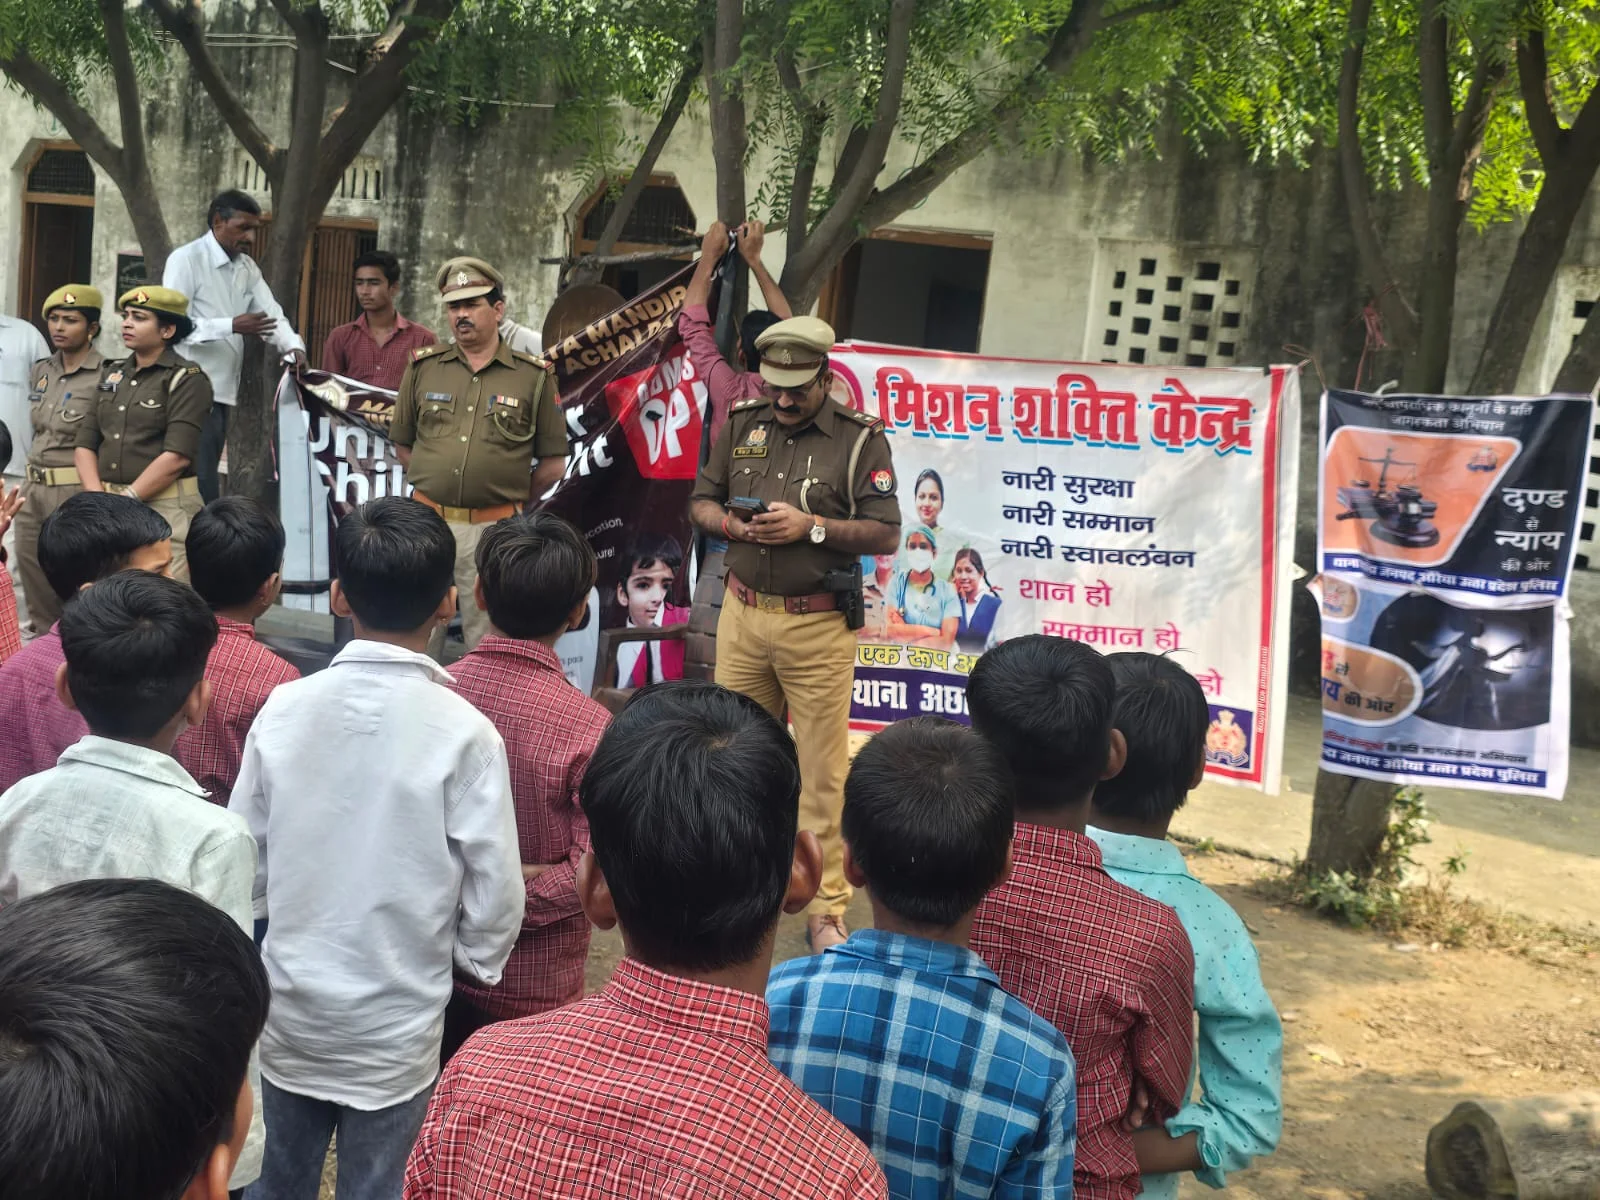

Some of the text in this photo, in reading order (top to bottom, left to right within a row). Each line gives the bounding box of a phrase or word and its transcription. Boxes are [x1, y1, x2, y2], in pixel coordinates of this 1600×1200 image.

[873, 366, 1254, 457] मिशन शक्ति केन्द्र
[1493, 401, 1507, 414] के
[1001, 466, 1136, 503] नारी सुरक्षा
[1501, 487, 1568, 513] दण्ड
[1002, 501, 1156, 533] नारी सम्मान
[1525, 516, 1539, 531] से
[1001, 535, 1197, 568] नारी स्वावलंबन
[1494, 530, 1565, 551] न्याय
[1501, 557, 1551, 571] की ओर
[1019, 578, 1112, 607] शान हो
[1153, 621, 1181, 651] हो
[857, 644, 903, 666] एक
[906, 645, 951, 671] रूप
[853, 679, 908, 710] थाना
[1195, 668, 1223, 696] हो
[1344, 691, 1362, 708] की
[1497, 766, 1539, 783] पुलिस
